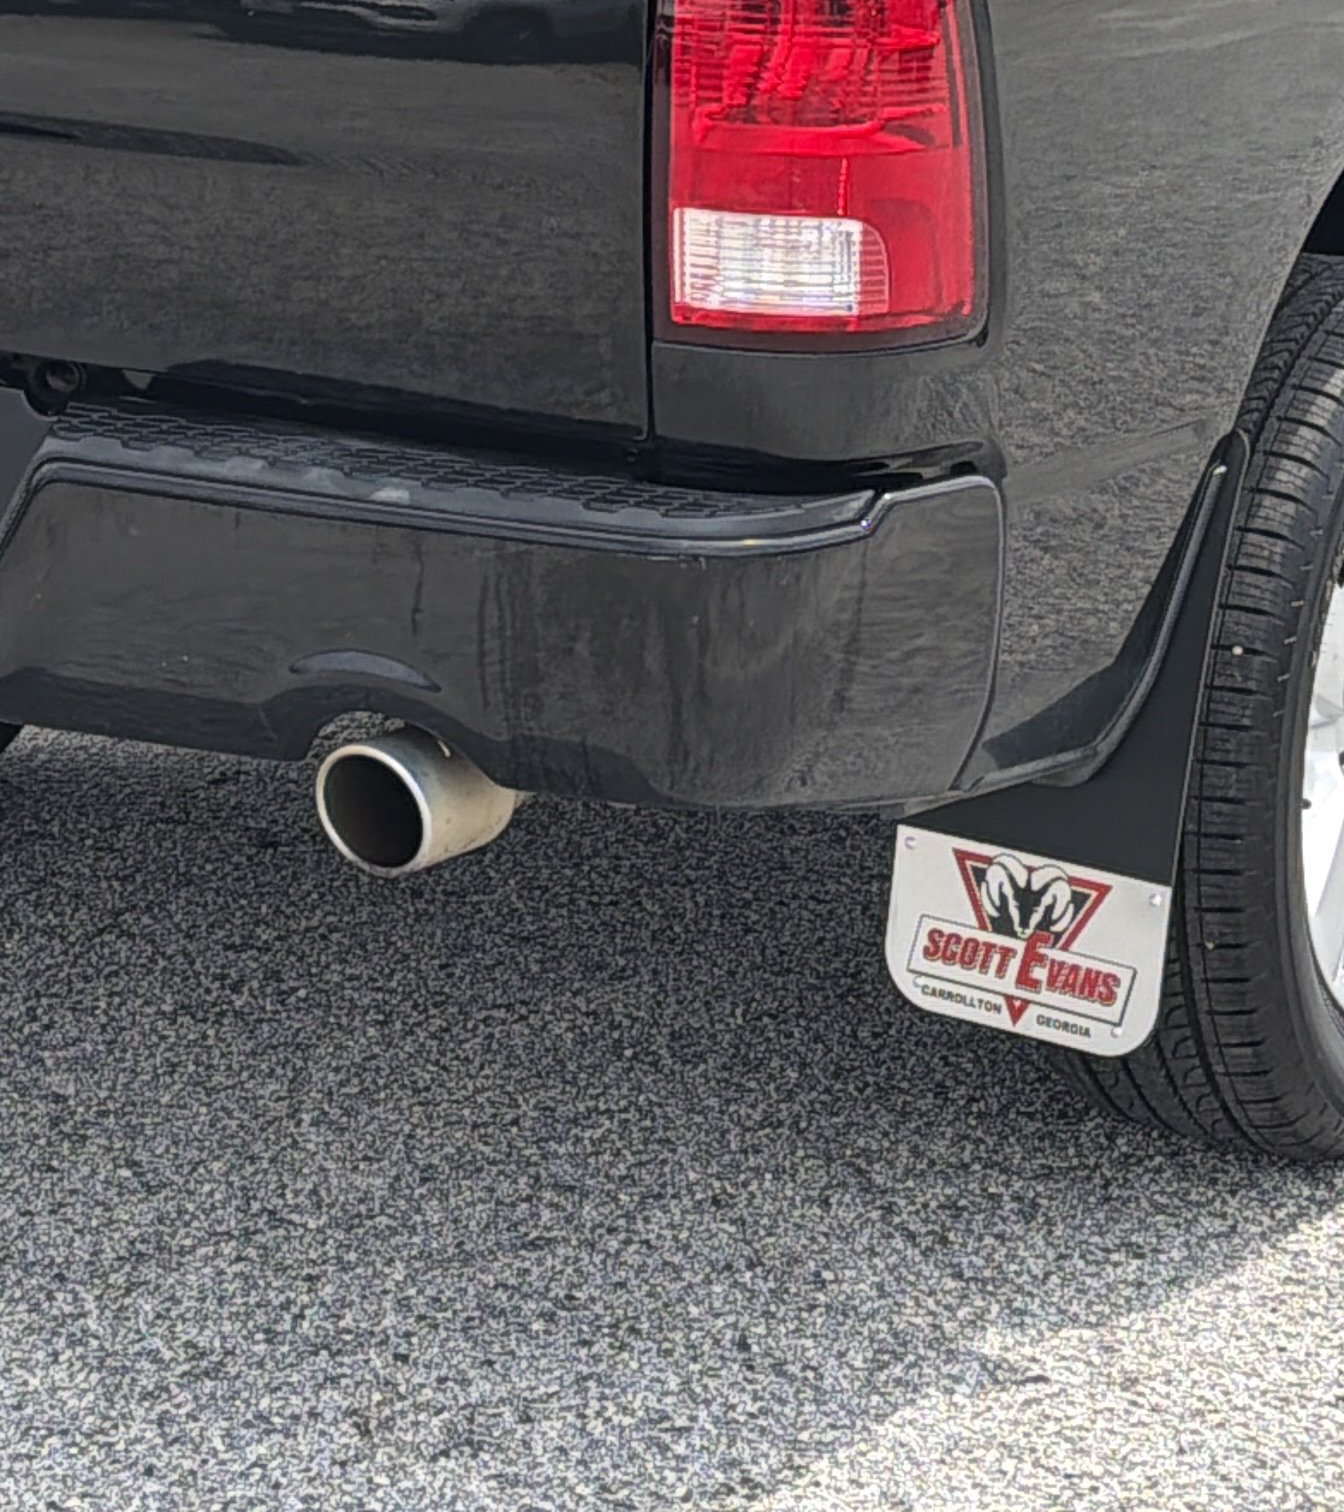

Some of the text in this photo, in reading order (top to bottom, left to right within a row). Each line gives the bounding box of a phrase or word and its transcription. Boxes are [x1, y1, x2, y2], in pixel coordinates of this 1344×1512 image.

[923, 928, 1121, 1007] SCOTT EVANS
[921, 984, 1091, 1039] CARROLLTON GEORGIA
